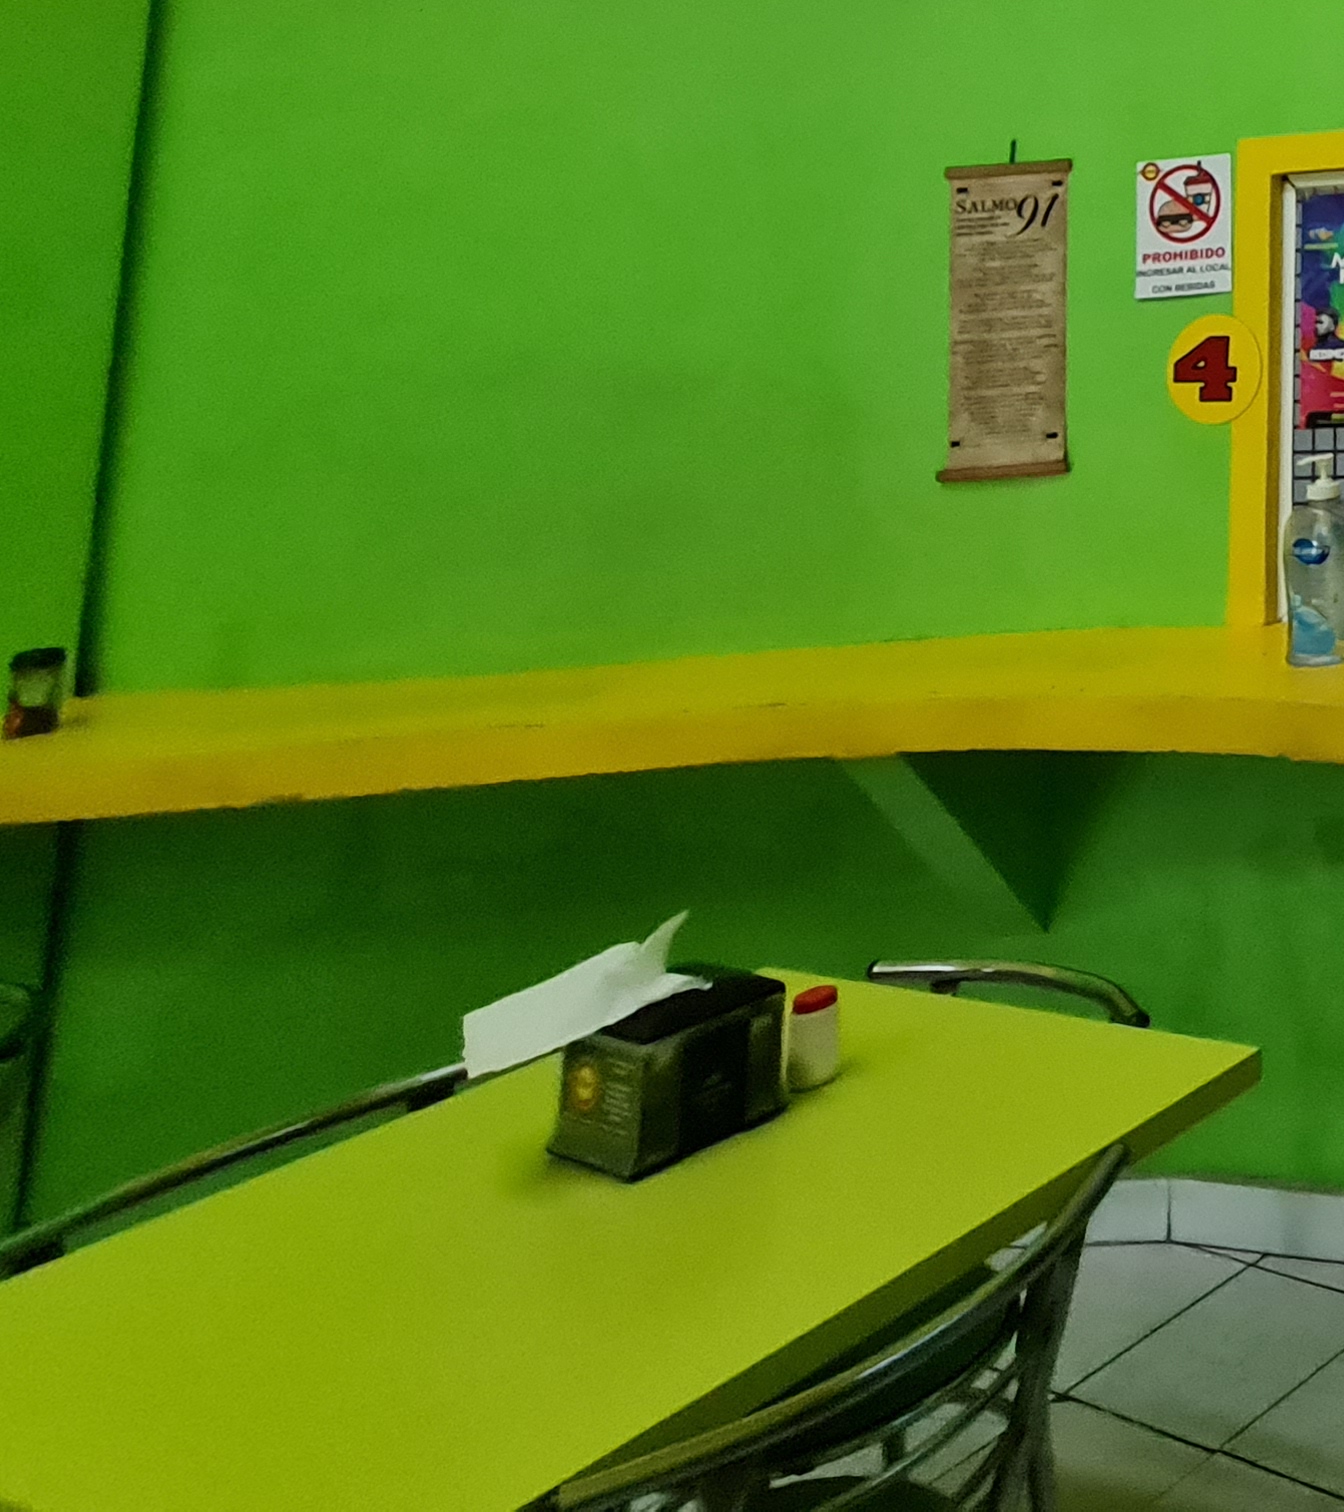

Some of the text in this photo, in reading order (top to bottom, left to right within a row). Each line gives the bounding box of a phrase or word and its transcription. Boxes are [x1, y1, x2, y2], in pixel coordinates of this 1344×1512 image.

[956, 197, 1018, 214] SALMO
[1005, 193, 1060, 239] 91
[1142, 246, 1226, 265] PROHIBIDO
[1136, 263, 1230, 277] INGRESAR AL LOCAL
[1152, 283, 1173, 294] CON
[1173, 335, 1238, 402] 4
